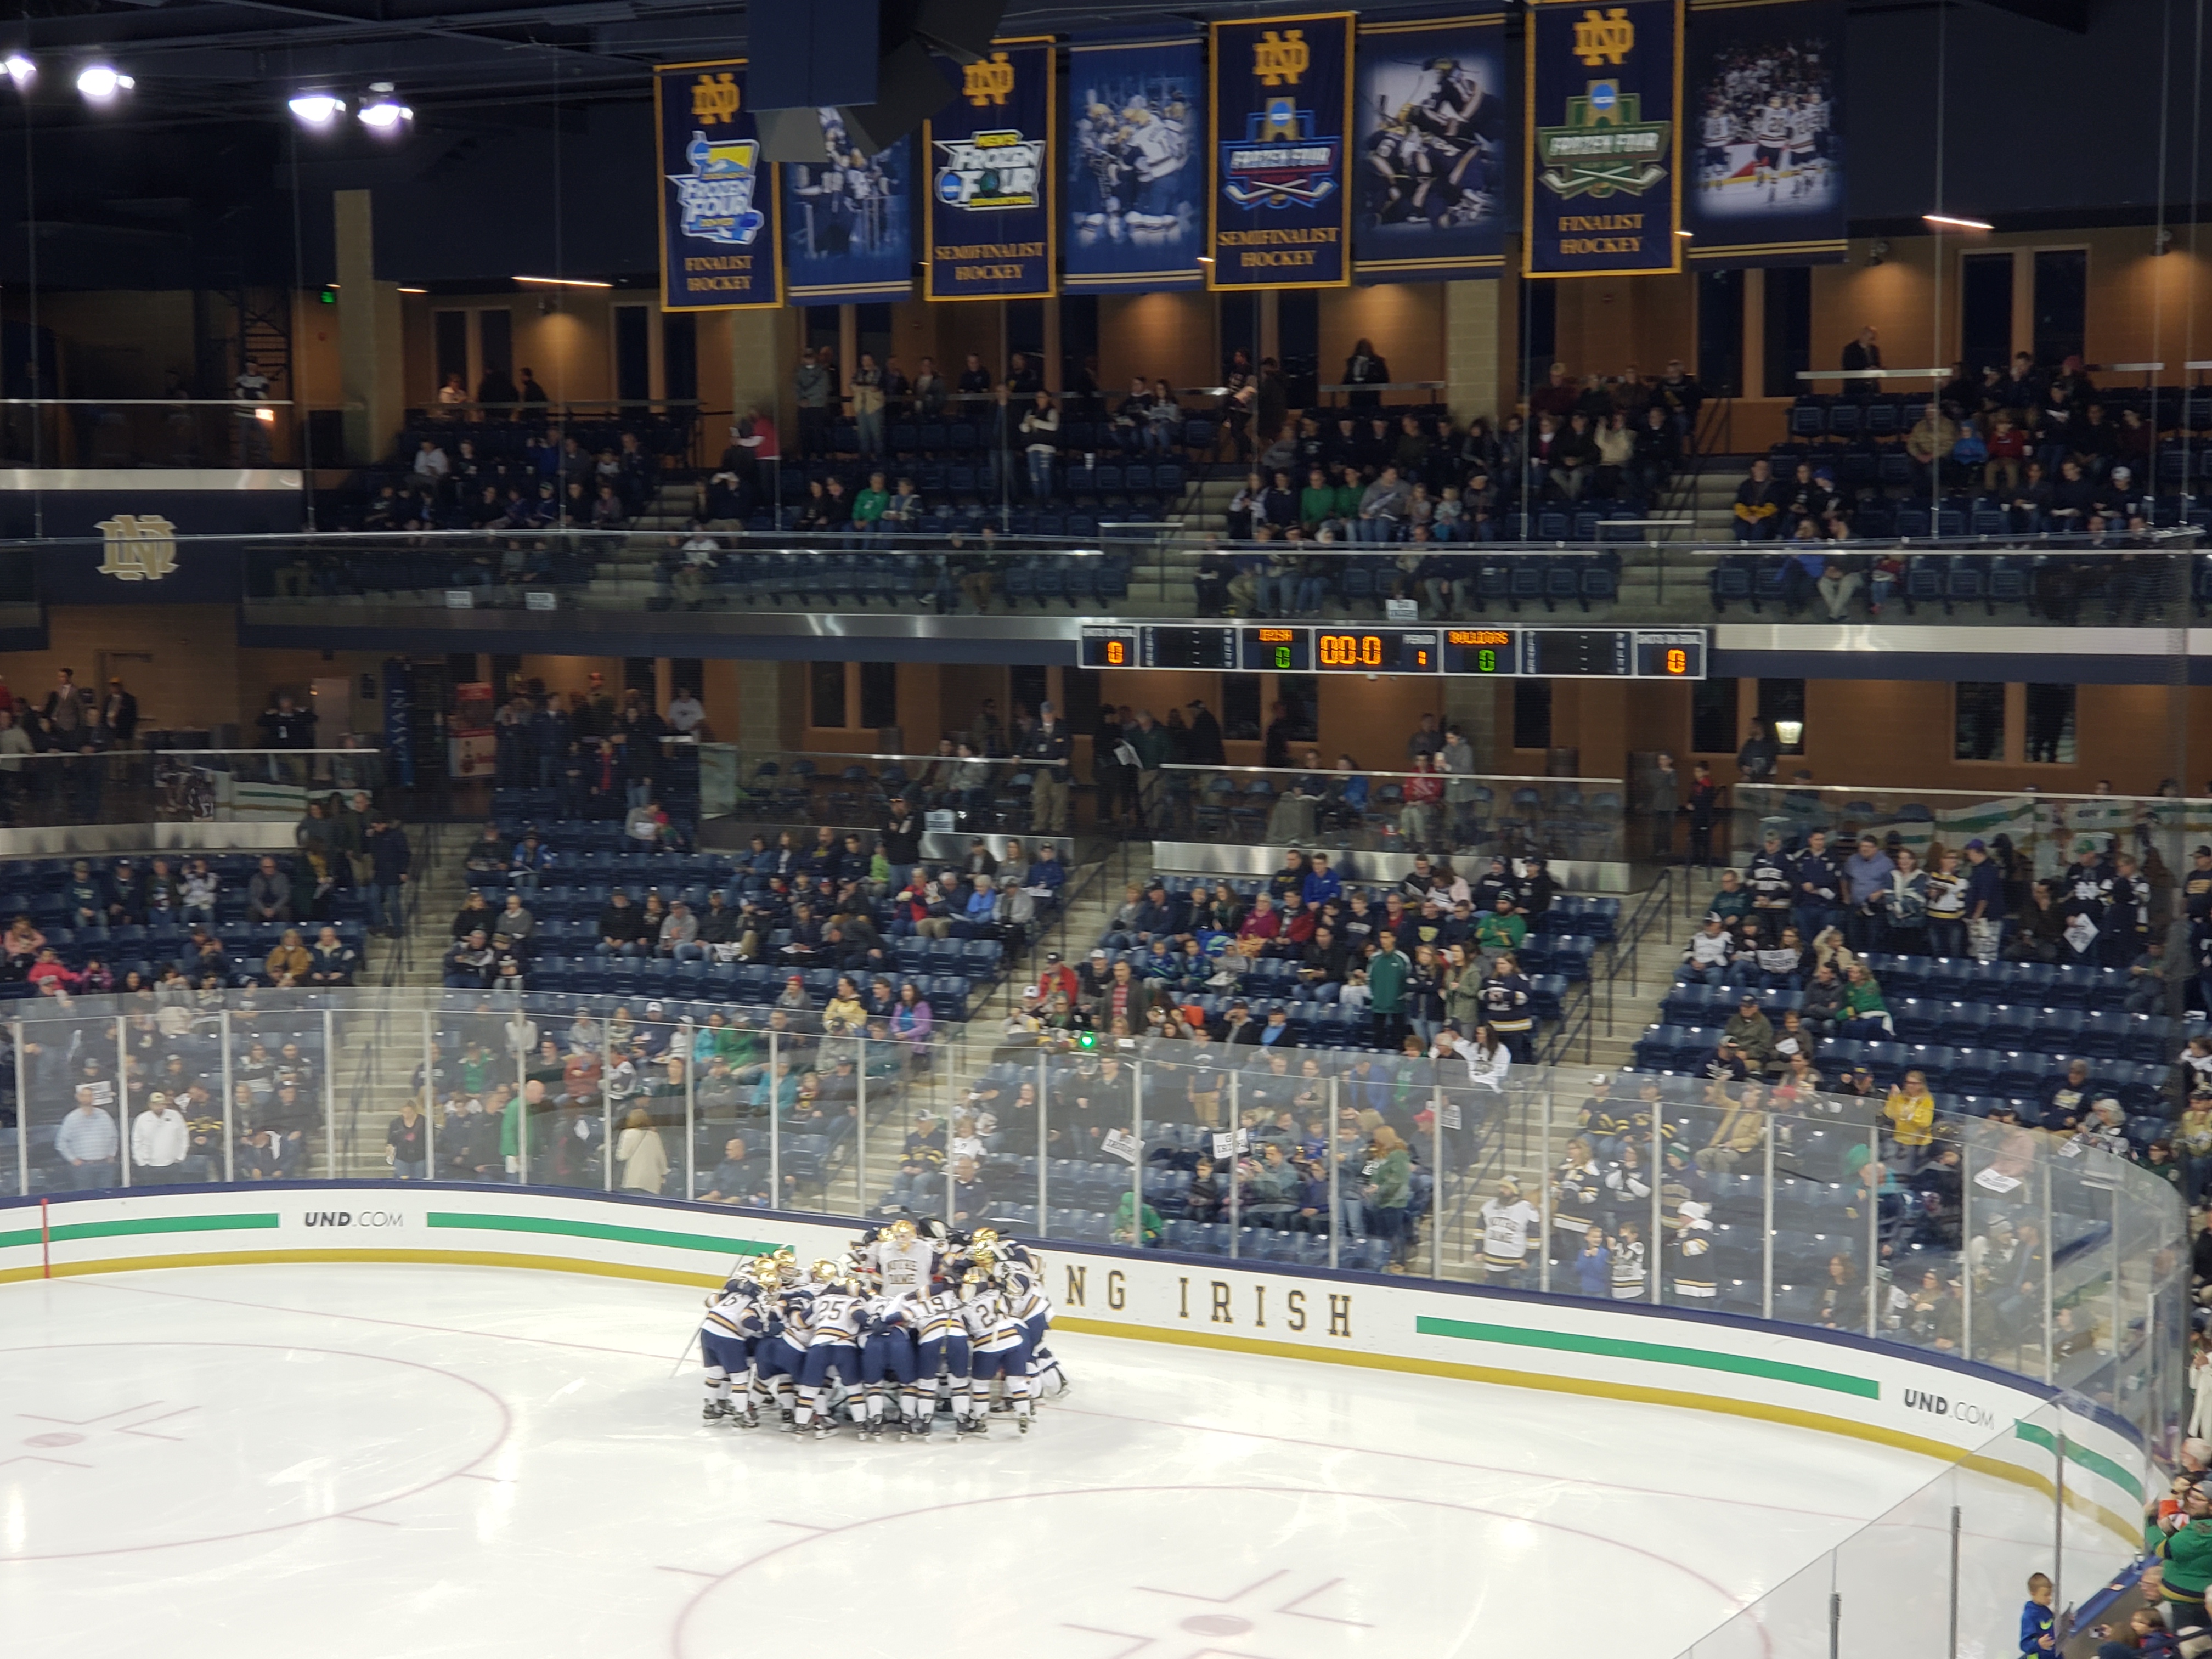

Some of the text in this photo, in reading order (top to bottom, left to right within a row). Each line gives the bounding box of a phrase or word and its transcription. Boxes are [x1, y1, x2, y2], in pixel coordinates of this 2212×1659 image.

[1558, 214, 1644, 232] FINALIST
[1217, 227, 1340, 246] SEMIFINALIST
[1559, 237, 1643, 254] HOCKEY
[934, 242, 1045, 260] SEMIFINALIST
[1241, 250, 1316, 267] HOCKEY
[684, 256, 753, 271] FINALIST
[955, 264, 1024, 280] HOCKEY
[686, 276, 752, 291] HOCKEY
[1107, 641, 1123, 664] 0
[1275, 646, 1291, 668] 0
[1479, 649, 1496, 672] 0
[1667, 649, 1686, 673] 0
[305, 1211, 403, 1227] UND.COM
[1064, 1264, 1352, 1338] NG IRISH
[1904, 1388, 1995, 1430] UND.COM
